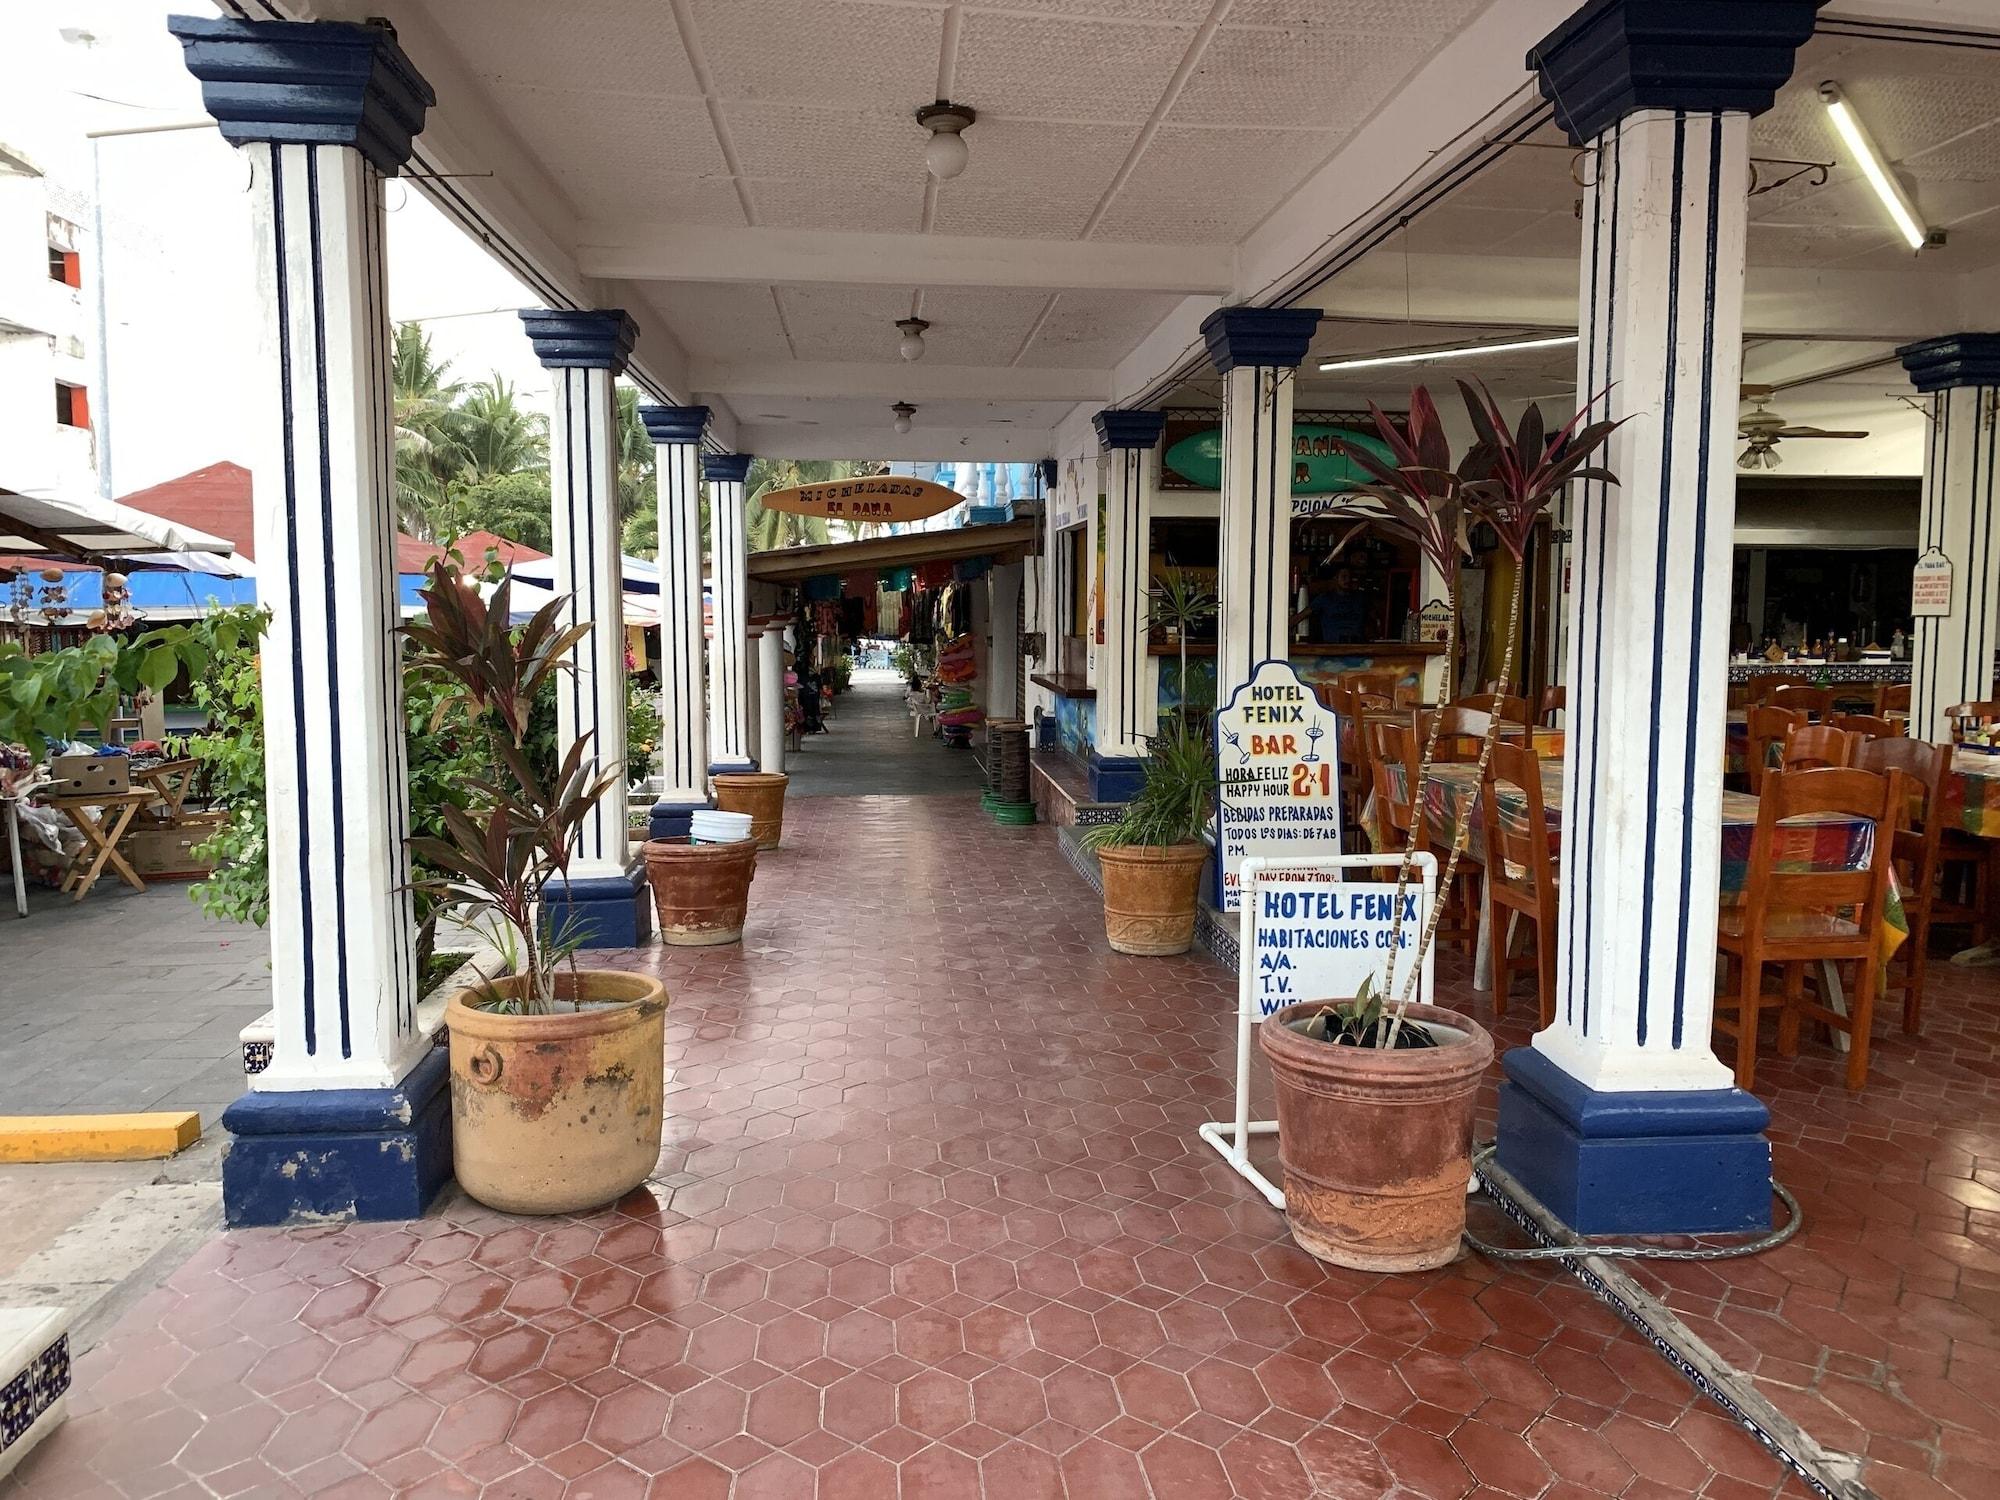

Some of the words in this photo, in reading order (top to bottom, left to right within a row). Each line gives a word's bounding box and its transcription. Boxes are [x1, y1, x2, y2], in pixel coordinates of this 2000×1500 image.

[800, 483, 923, 502] MICHELADAS
[1252, 686, 1304, 701] HOTEL
[1243, 705, 1304, 723] FENIX
[1251, 734, 1297, 755] BAR
[1226, 768, 1255, 780] HORA
[1256, 767, 1289, 781] FELIZ
[1226, 784, 1262, 798] HAPPY
[1263, 784, 1290, 797] HOUR
[1224, 807, 1265, 823] BEBIDAS
[1269, 806, 1333, 821] PREPARADAS
[1225, 828, 1257, 840] TODOS
[1228, 845, 1248, 857] P.M.
[1264, 892, 1344, 919] HOTEL
[1258, 928, 1369, 948] HABITACIONES
[1260, 951, 1297, 973] A/A.
[1260, 975, 1292, 993] T.V.
